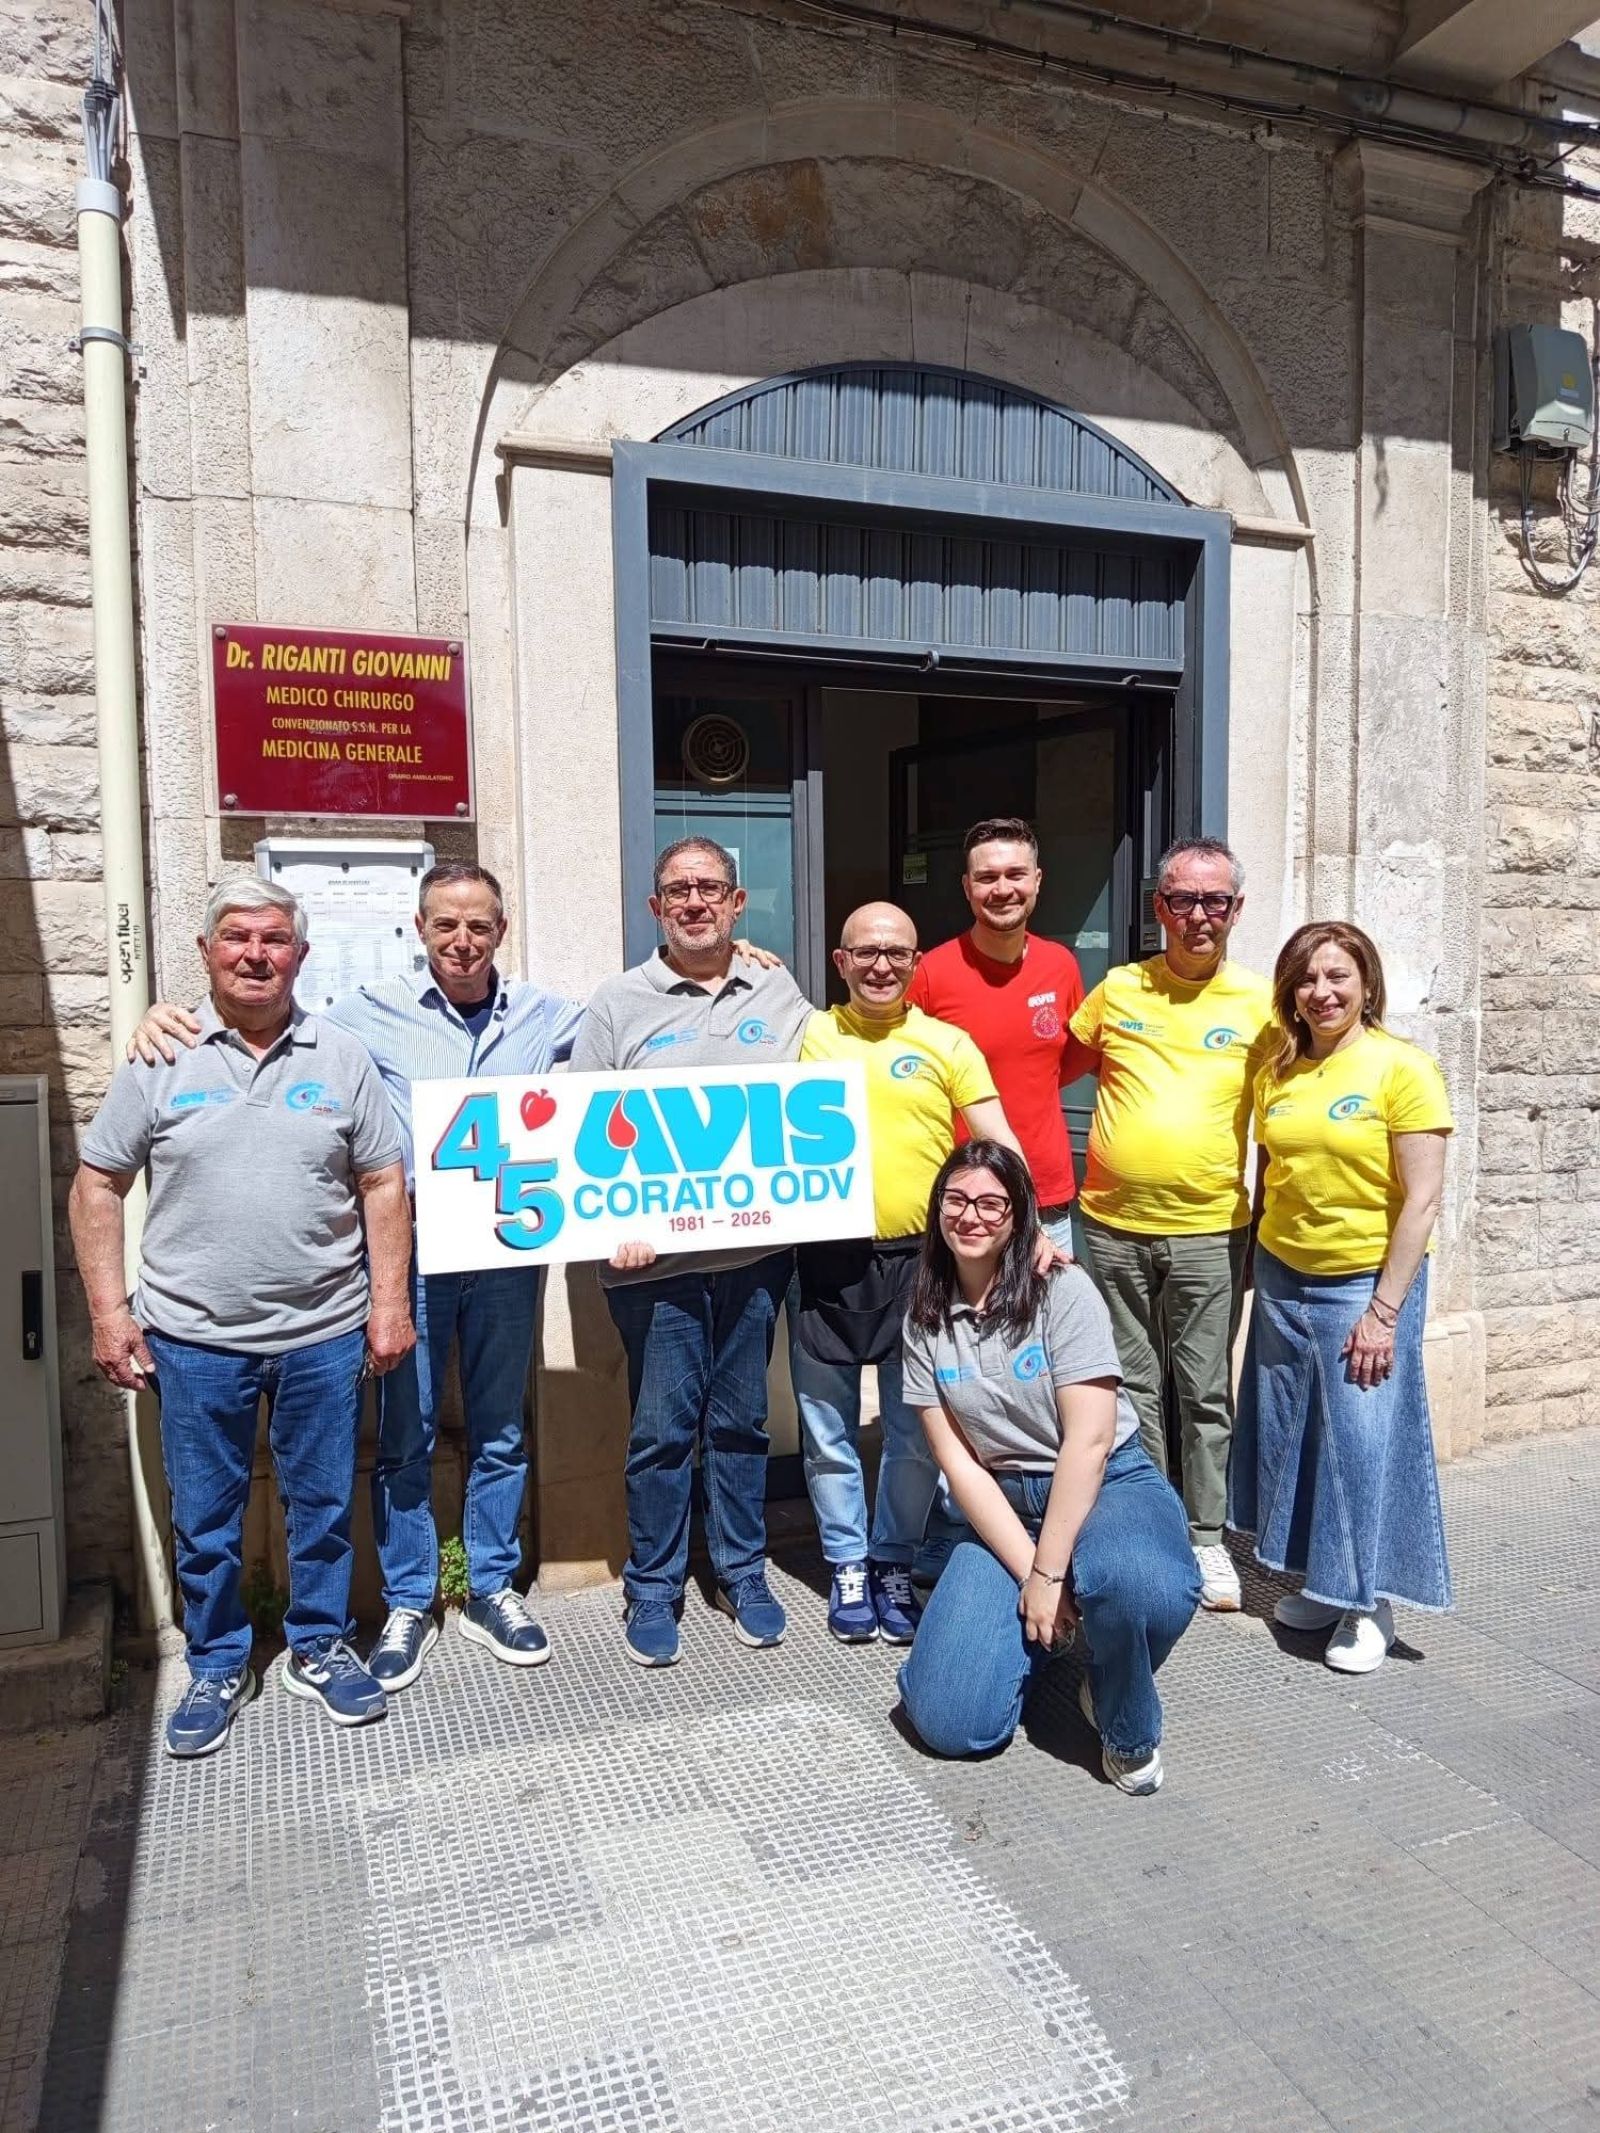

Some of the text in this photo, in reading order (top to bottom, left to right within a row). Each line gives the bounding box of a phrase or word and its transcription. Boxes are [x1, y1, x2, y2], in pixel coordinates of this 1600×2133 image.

[227, 641, 452, 681] Dr. RIGANTI GIOVANNI
[266, 686, 414, 711] MEDICO CHIRURGO
[272, 717, 350, 732] CONVENZIONATO
[381, 723, 399, 734] PER
[400, 724, 411, 735] LA
[262, 740, 423, 763] MEDICINA GENERALE
[119, 941, 135, 984] open
[575, 1079, 856, 1179] AVIS
[574, 1167, 855, 1219] CORATO ODV
[669, 1216, 706, 1232] 1981
[731, 1210, 772, 1227] 2026
